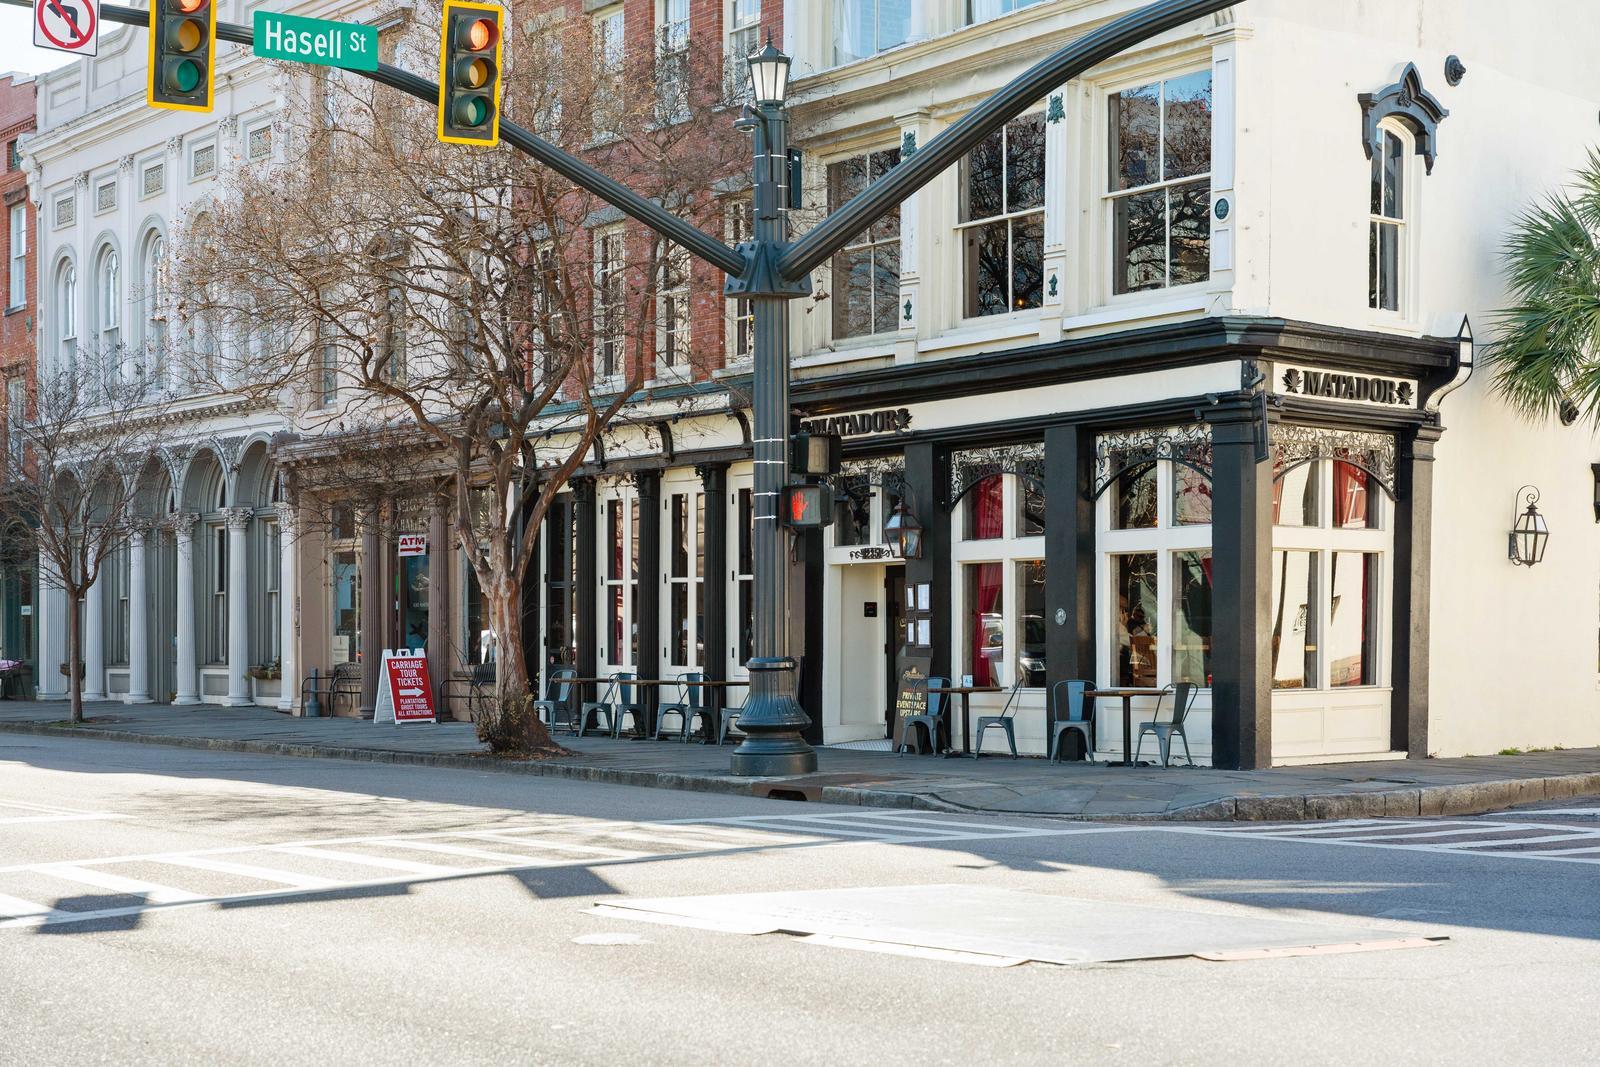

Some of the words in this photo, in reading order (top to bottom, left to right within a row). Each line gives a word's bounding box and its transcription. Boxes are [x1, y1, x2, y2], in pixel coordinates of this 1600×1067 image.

[265, 20, 341, 59] Hasell
[349, 31, 367, 53] St
[1302, 370, 1397, 404] MATADOR
[810, 410, 897, 436] MATADOR
[400, 537, 425, 546] ATM
[391, 661, 423, 669] CARRIAGE
[400, 669, 418, 677] TOUR
[396, 678, 423, 686] TICKETS
